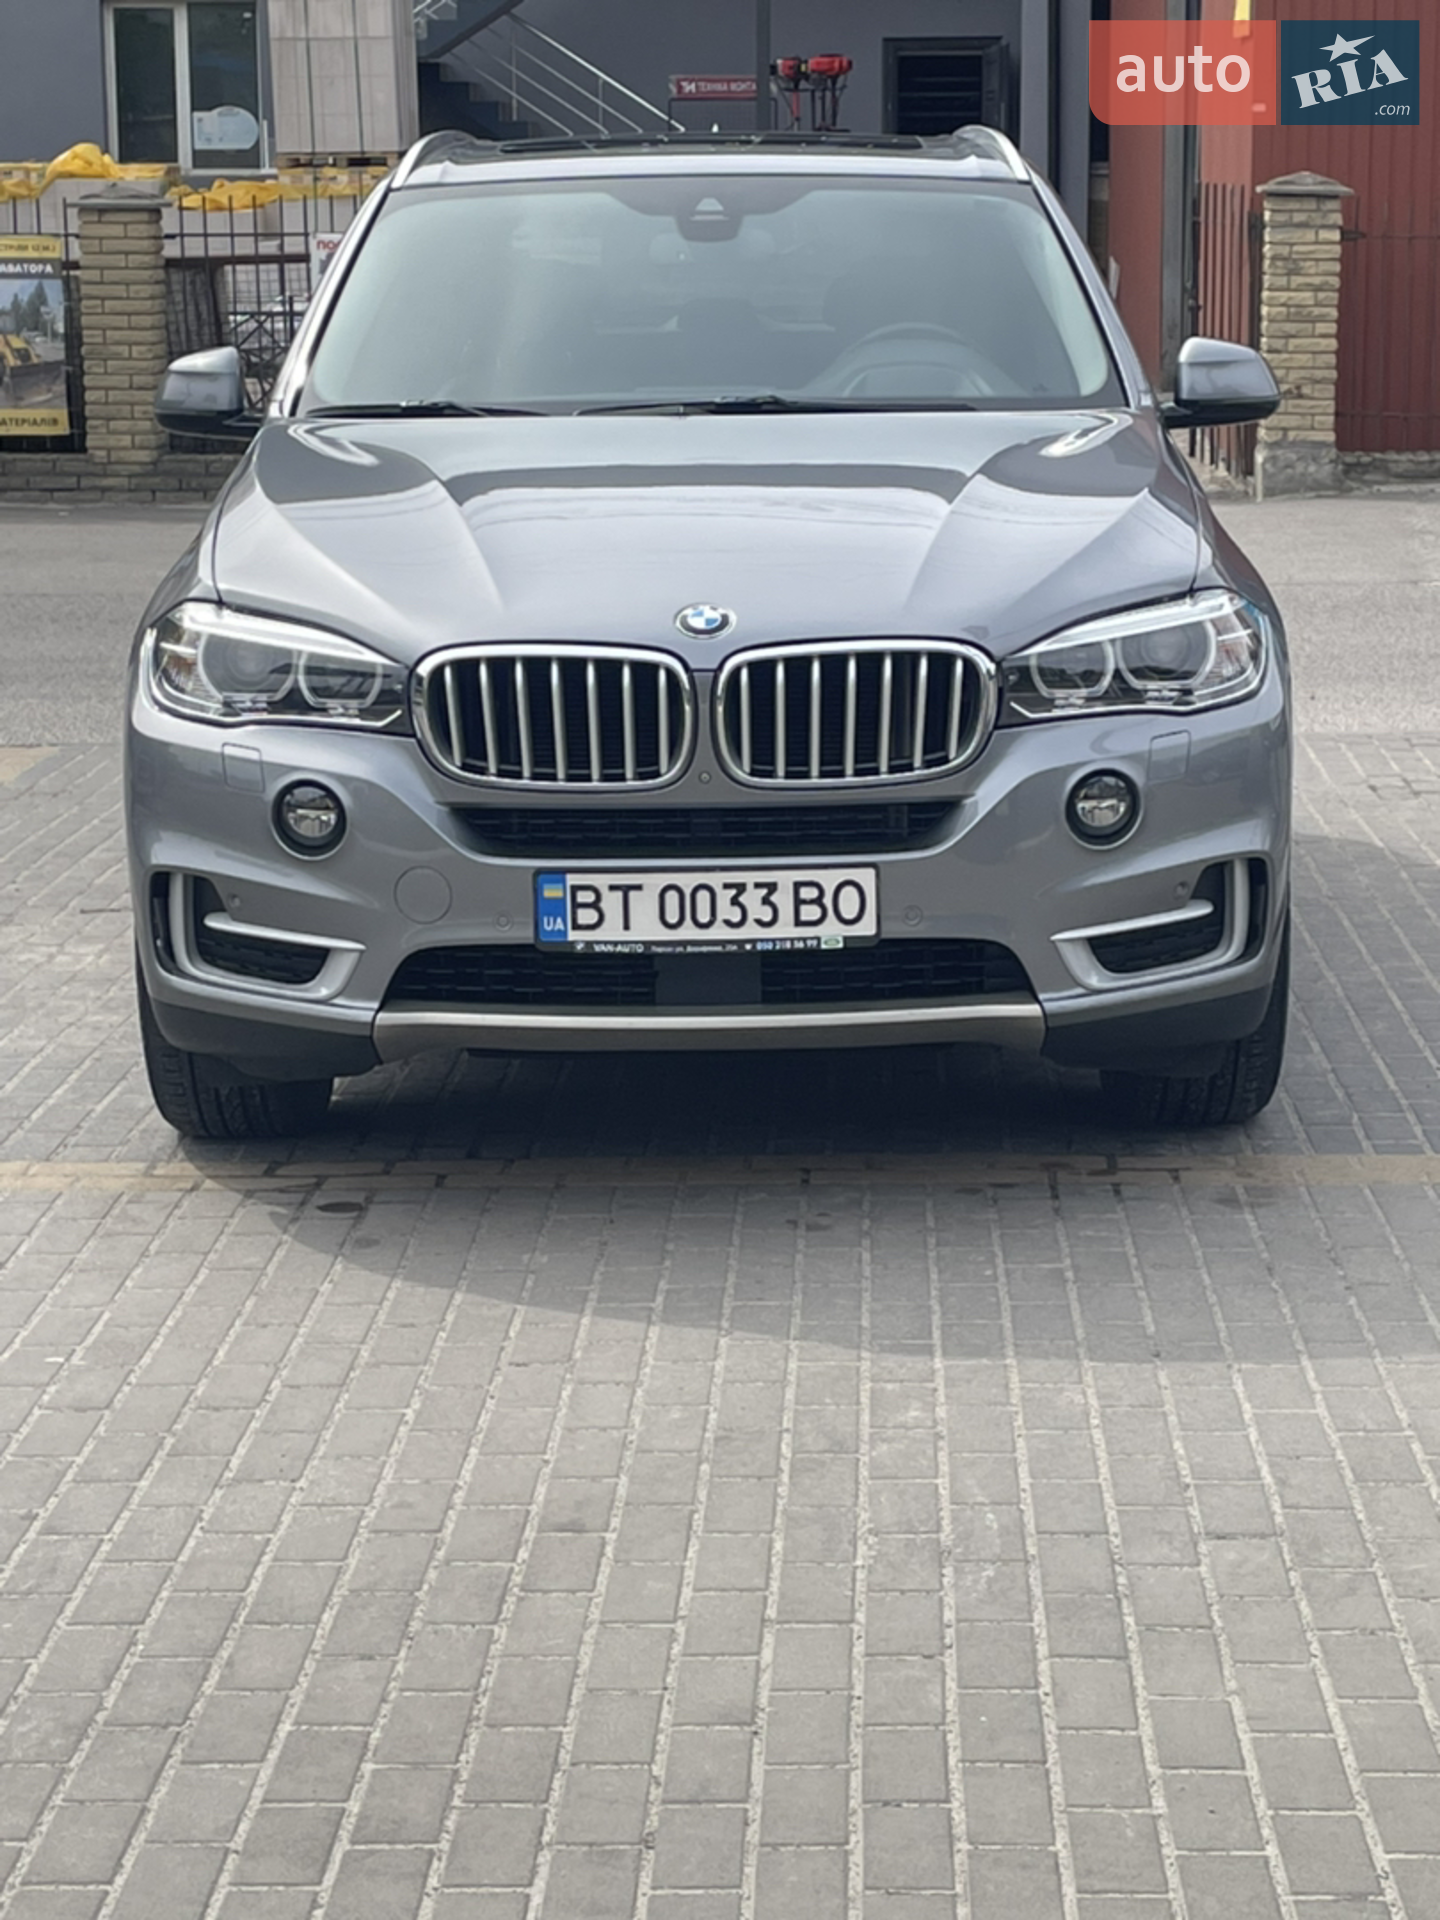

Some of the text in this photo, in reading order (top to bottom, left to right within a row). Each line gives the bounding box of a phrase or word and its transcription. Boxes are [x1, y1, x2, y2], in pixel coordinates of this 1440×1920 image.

[569, 879, 868, 931] BT 0033 BO
[543, 917, 565, 931] UA
[593, 943, 645, 954] VAN-AUTO
